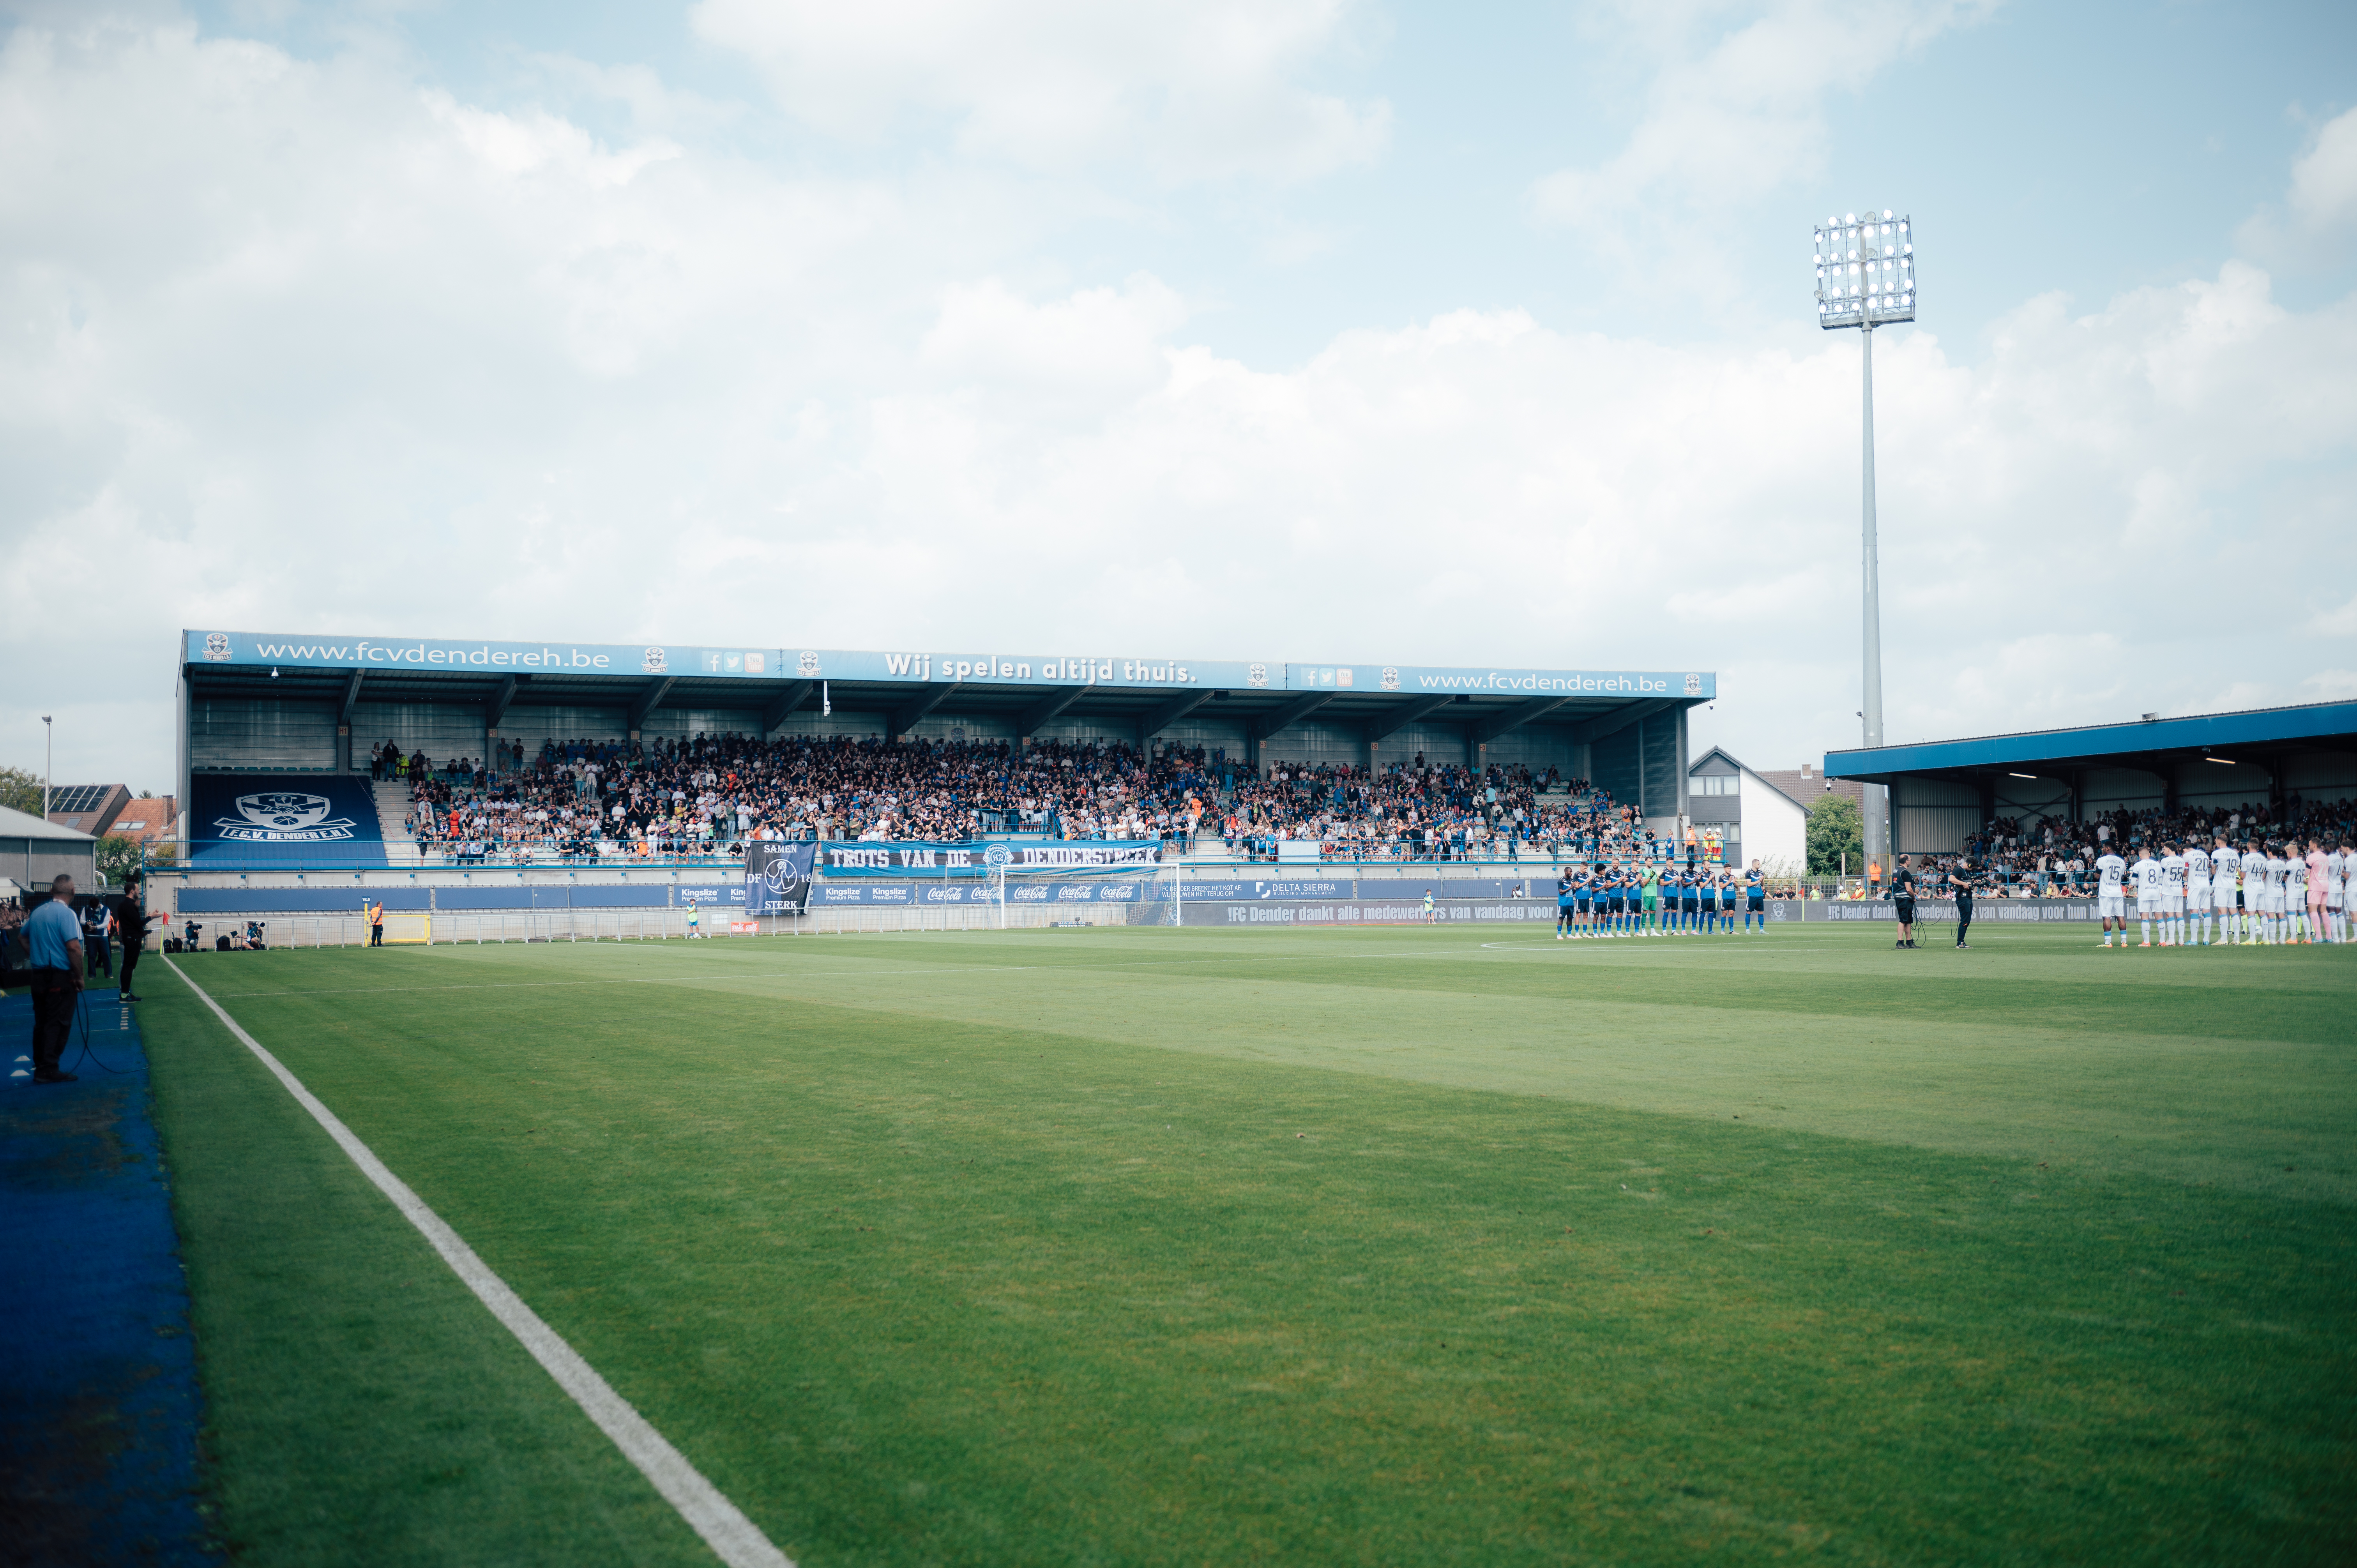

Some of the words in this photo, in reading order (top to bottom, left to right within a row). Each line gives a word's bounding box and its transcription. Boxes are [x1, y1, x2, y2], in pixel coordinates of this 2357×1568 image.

[256, 642, 610, 667] www.fcvdendereh.be
[885, 654, 931, 681] Wij
[942, 656, 1031, 680] spelen
[1042, 658, 1113, 684] altijd
[1124, 660, 1196, 682] thuis.
[1419, 673, 1666, 692] www.fcvdendereh.be
[229, 829, 263, 839] F.C.V.
[319, 830, 346, 838] E.H.
[764, 845, 797, 853] SAMEN
[830, 849, 889, 867] TROTS
[900, 849, 936, 868] VAN
[946, 850, 971, 867] DE
[1022, 847, 1157, 864] DENDERSTREEK
[2194, 858, 2209, 872] 20
[2226, 858, 2237, 873] 19
[747, 873, 762, 883] DF
[800, 872, 811, 883] 18
[2108, 865, 2120, 881] 15
[2149, 869, 2156, 884] 8
[2170, 867, 2182, 882] 55
[2274, 870, 2284, 884] 10
[682, 889, 717, 897] Kingslize
[873, 888, 906, 896] Kingslize
[928, 887, 963, 900] Coca-Cola
[1014, 886, 1049, 899] Coca-Cola
[1058, 885, 1093, 899] Coca-Cola
[1100, 885, 1134, 898] Coca-Cola
[765, 901, 797, 909] STERK
[1228, 907, 1246, 922] !FC
[1250, 906, 1295, 921] Dender
[1299, 906, 1334, 921] dankt
[1338, 905, 1360, 920] alle
[1364, 905, 1446, 920] medewerkrs
[1449, 907, 1471, 919] van
[1474, 904, 1524, 920] vandaag
[1527, 906, 1553, 918] voor
[1828, 905, 1840, 919] !FC
[1842, 905, 1870, 919] Dender
[1872, 905, 1896, 919] dankt
[1979, 906, 1995, 919] van
[1998, 904, 2039, 921] vandaag
[2042, 906, 2064, 919] voor
[2067, 904, 2087, 919] hun
